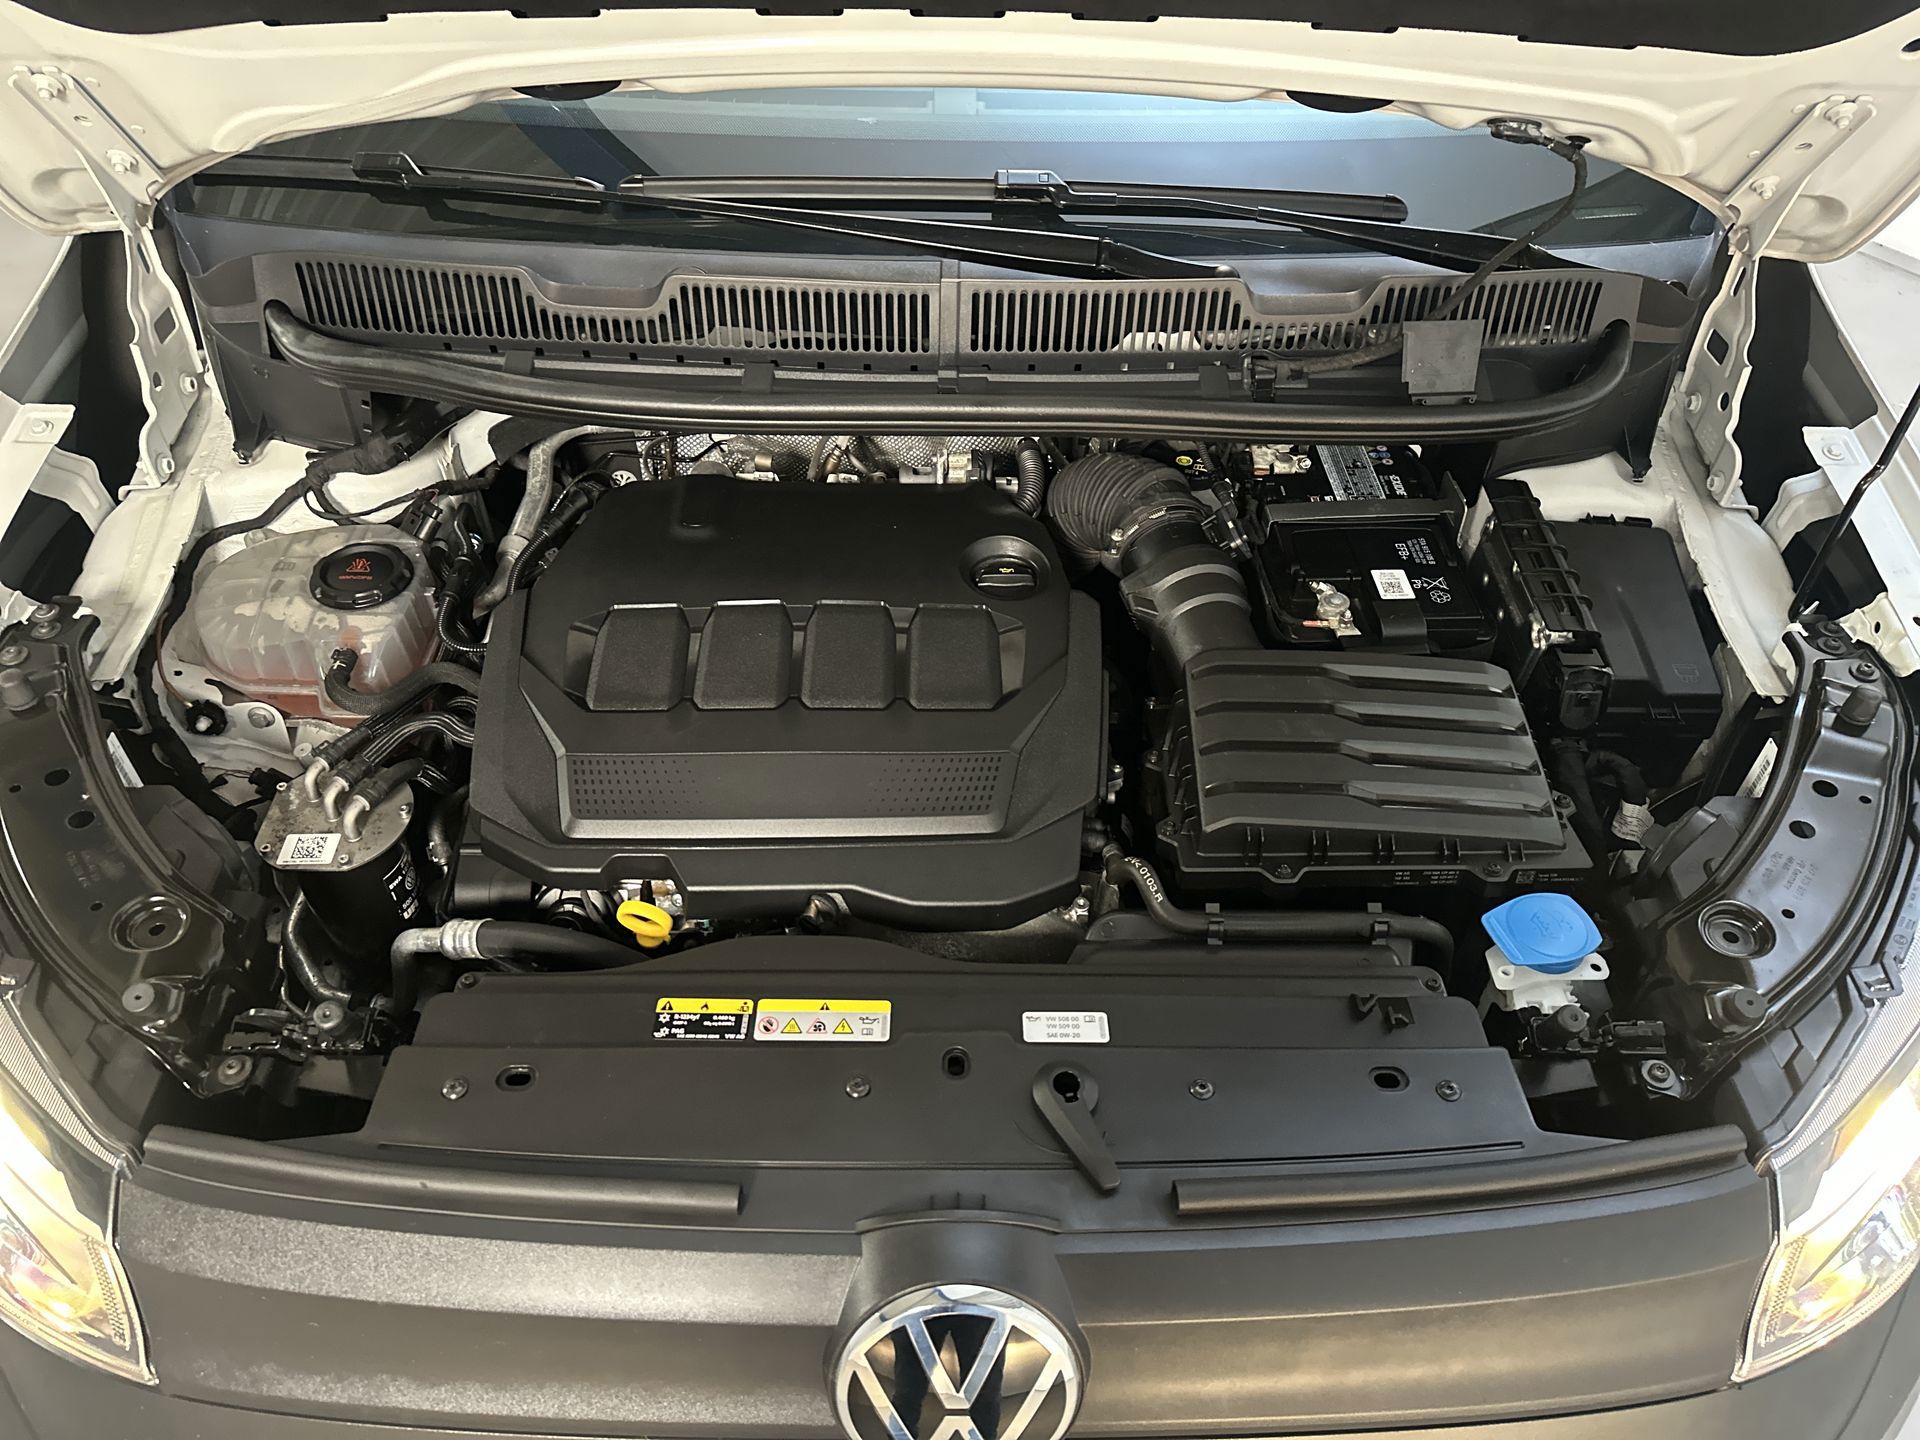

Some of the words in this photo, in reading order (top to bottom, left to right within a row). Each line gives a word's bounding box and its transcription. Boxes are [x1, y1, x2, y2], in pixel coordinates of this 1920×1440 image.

[1389, 474, 1408, 496] EXIDE
[1394, 543, 1410, 561] EFB+
[1139, 866, 1164, 903] 0103.R
[838, 1285, 1081, 1440] VW
